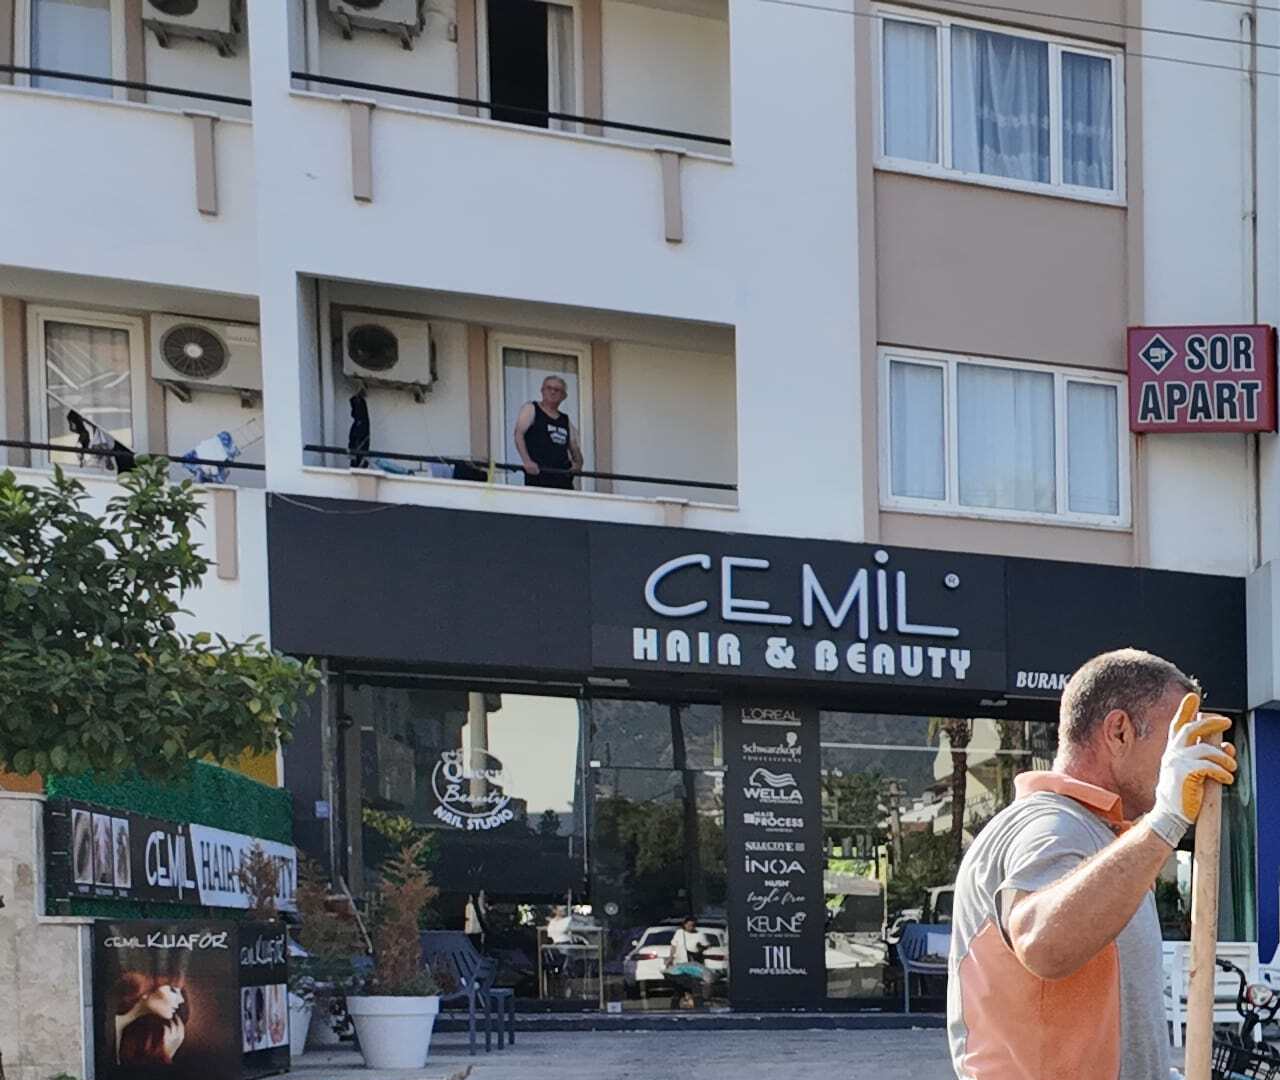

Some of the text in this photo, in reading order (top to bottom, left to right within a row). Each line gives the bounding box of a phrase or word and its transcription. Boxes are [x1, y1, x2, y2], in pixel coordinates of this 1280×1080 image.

[1186, 334, 1255, 372] SOR
[1138, 380, 1262, 423] APART
[644, 549, 959, 641] CEMİL
[632, 627, 971, 680] HAIR & BEAUTY
[1016, 671, 1071, 690] BURAK
[743, 787, 803, 804] WELLA
[200, 840, 235, 893] HAIR
[746, 915, 802, 933] KEUNE
